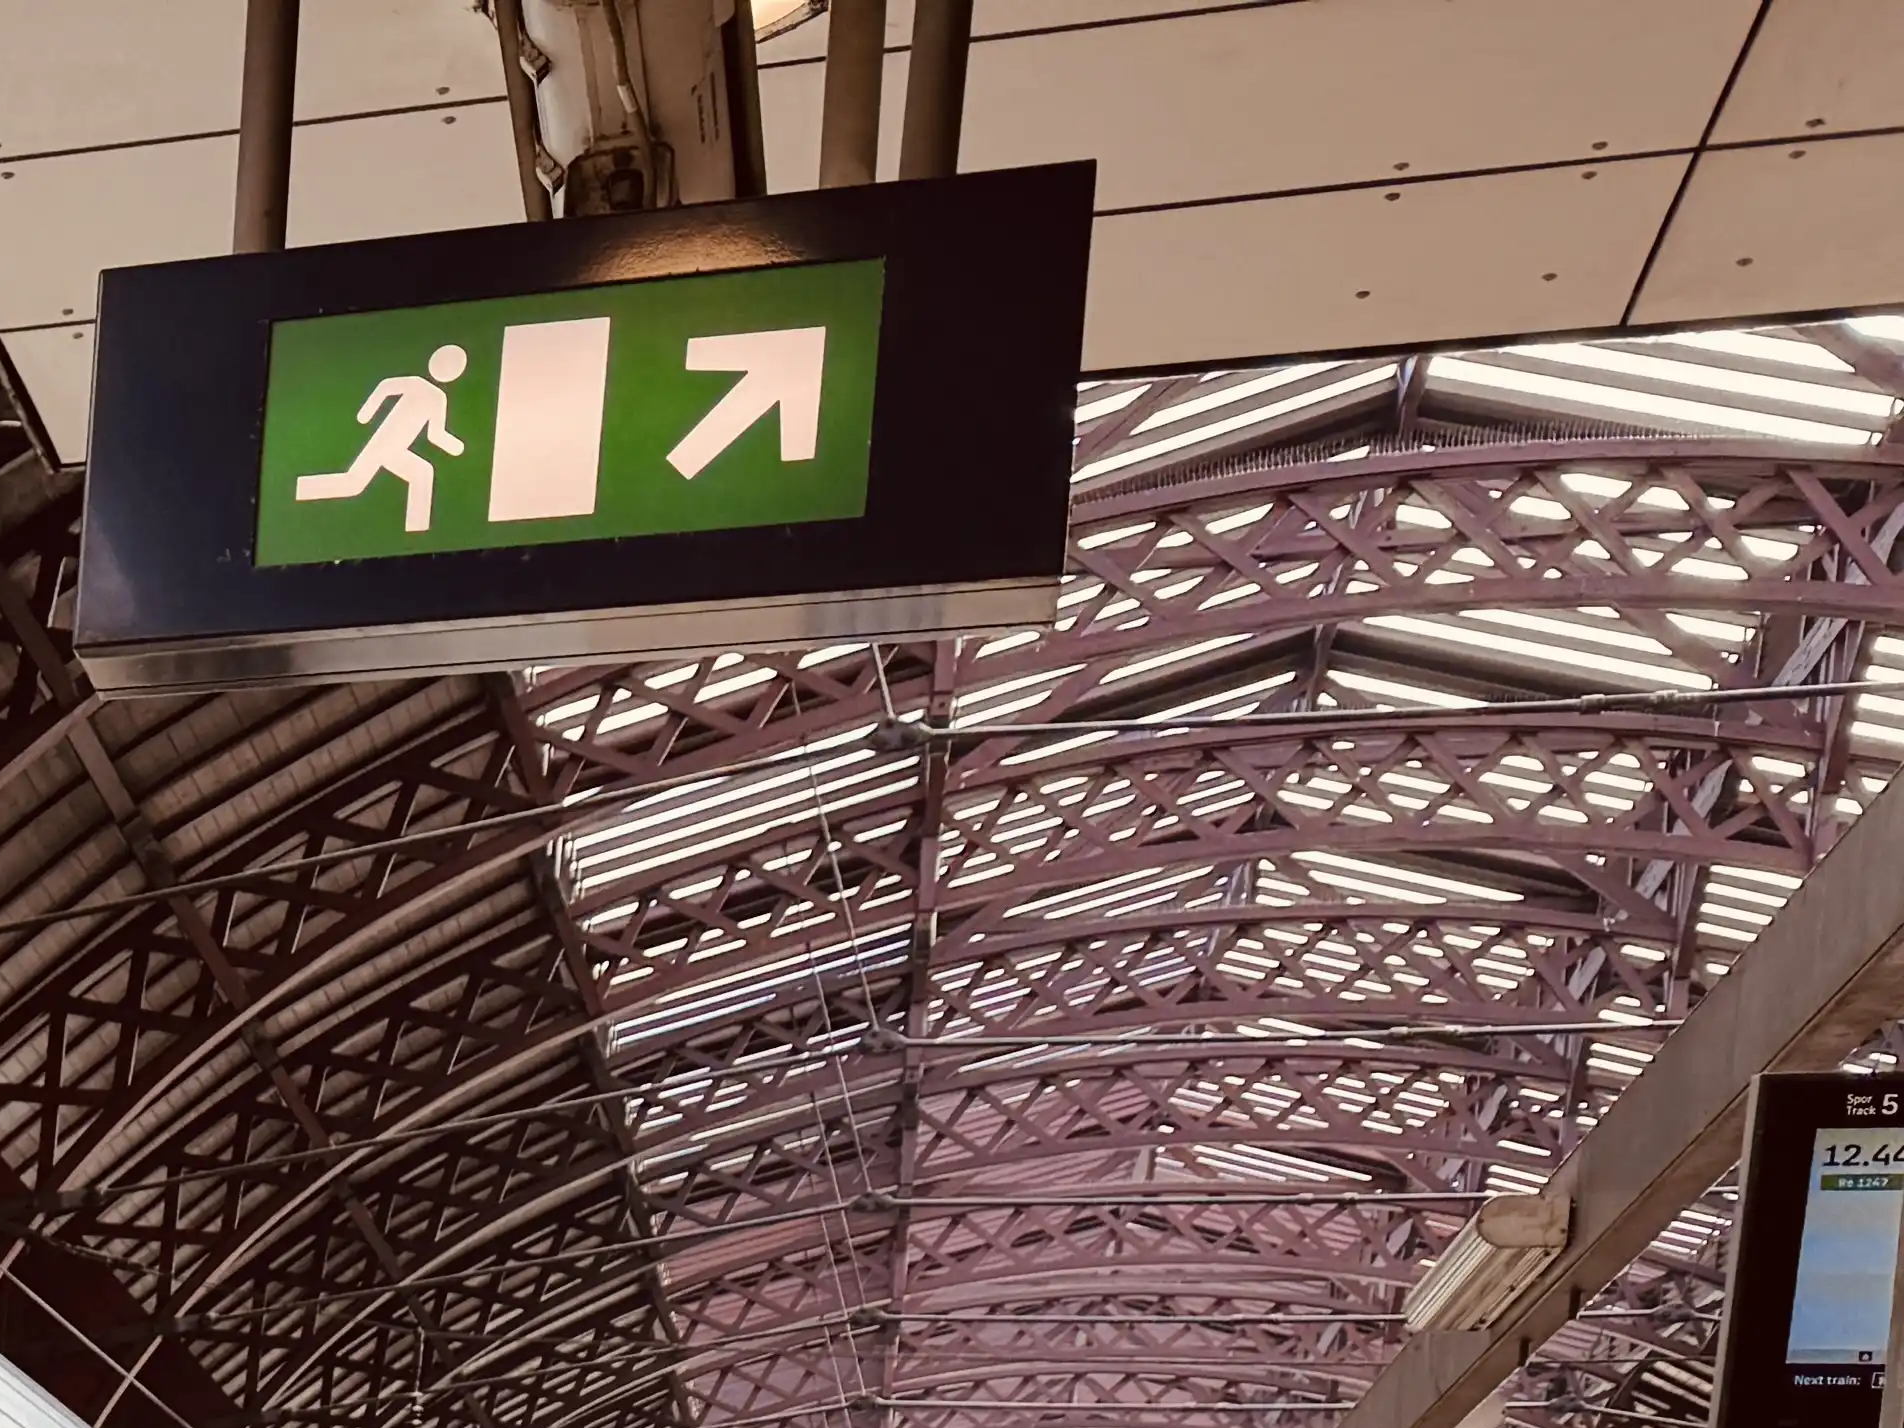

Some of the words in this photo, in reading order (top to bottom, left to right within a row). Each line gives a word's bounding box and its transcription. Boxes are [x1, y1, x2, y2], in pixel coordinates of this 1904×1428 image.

[1847, 1093, 1873, 1106] Spor
[1881, 1093, 1899, 1115] 5
[1846, 1105, 1876, 1116] Track
[1822, 1143, 1904, 1167] 12.44
[1794, 1374, 1824, 1386] Next
[1827, 1375, 1862, 1386] train:
